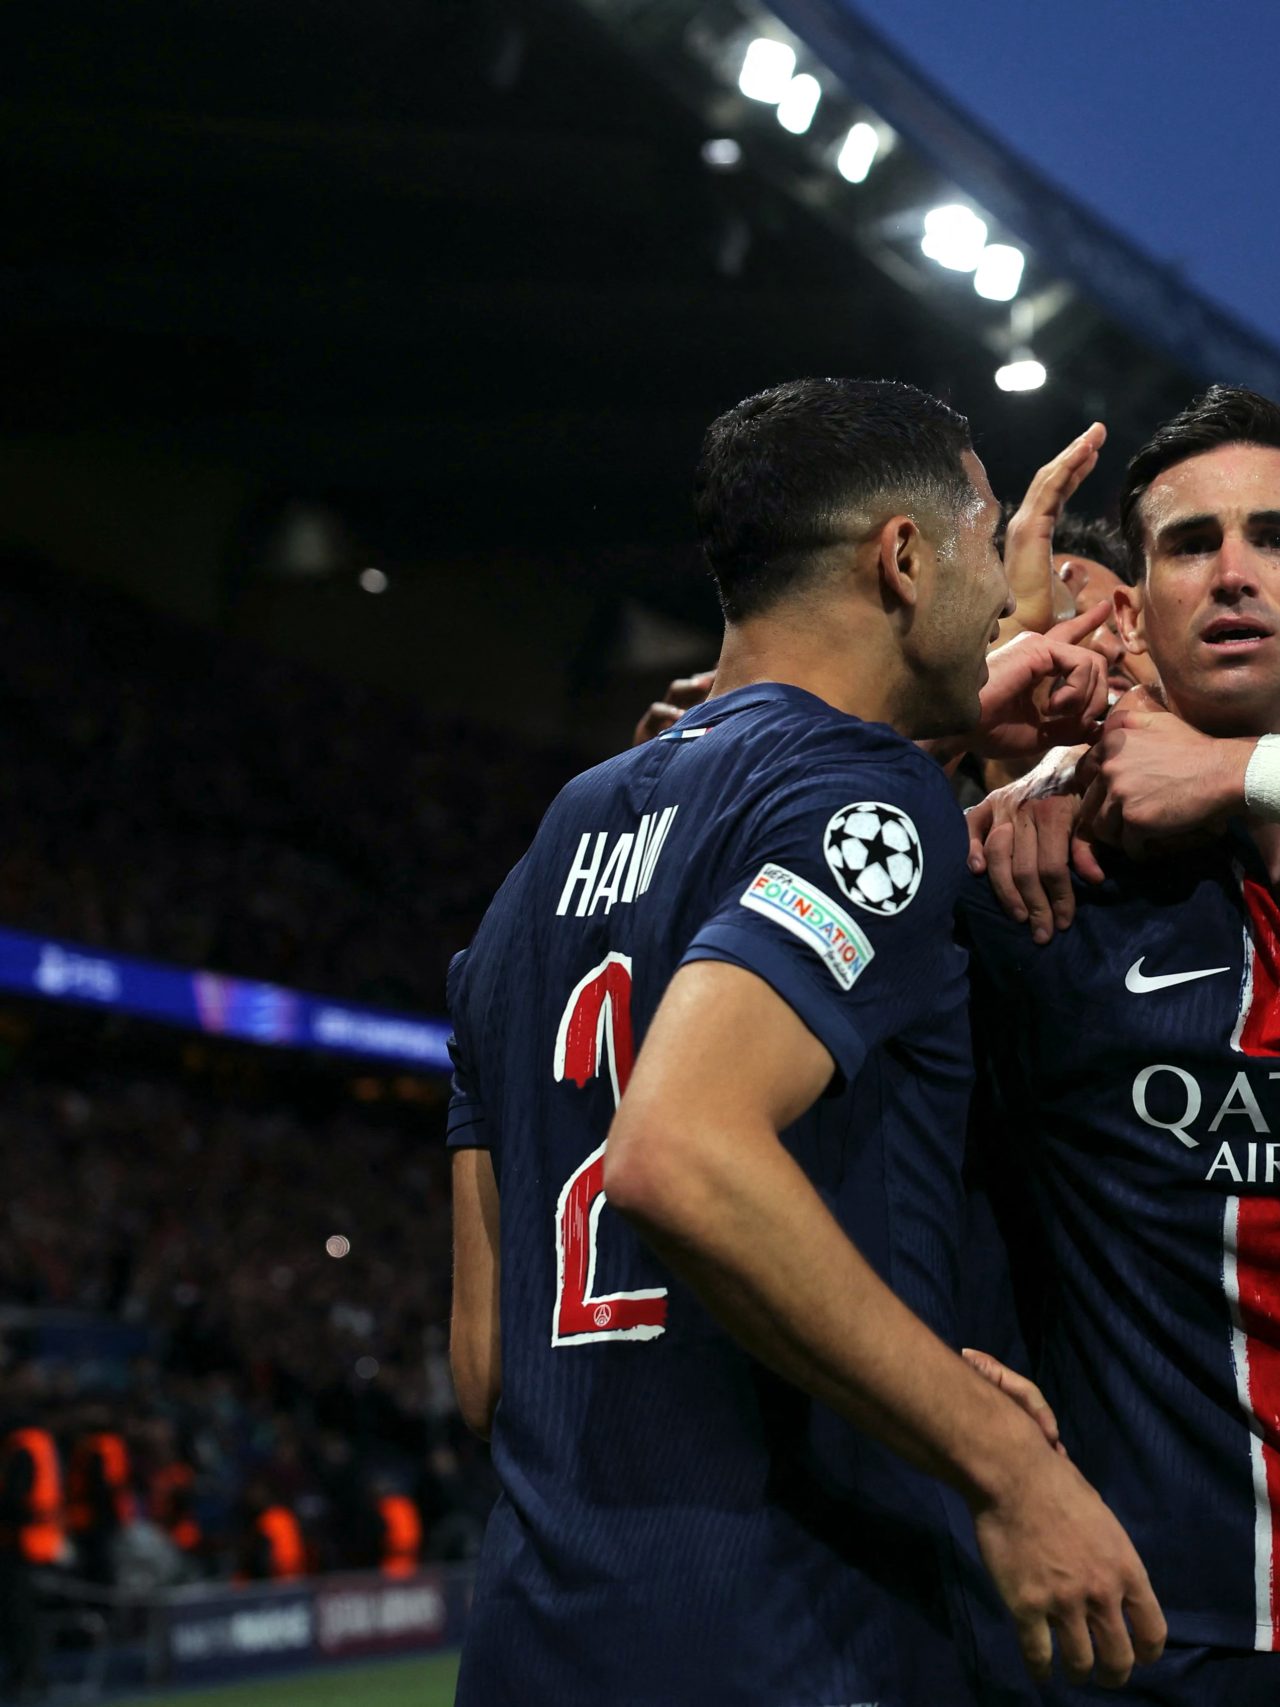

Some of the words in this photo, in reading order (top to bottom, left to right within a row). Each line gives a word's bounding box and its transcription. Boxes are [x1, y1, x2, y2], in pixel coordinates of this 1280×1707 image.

[752, 876, 863, 976] FOUNDATION
[762, 866, 794, 886] UEFA
[552, 952, 668, 1348] 2
